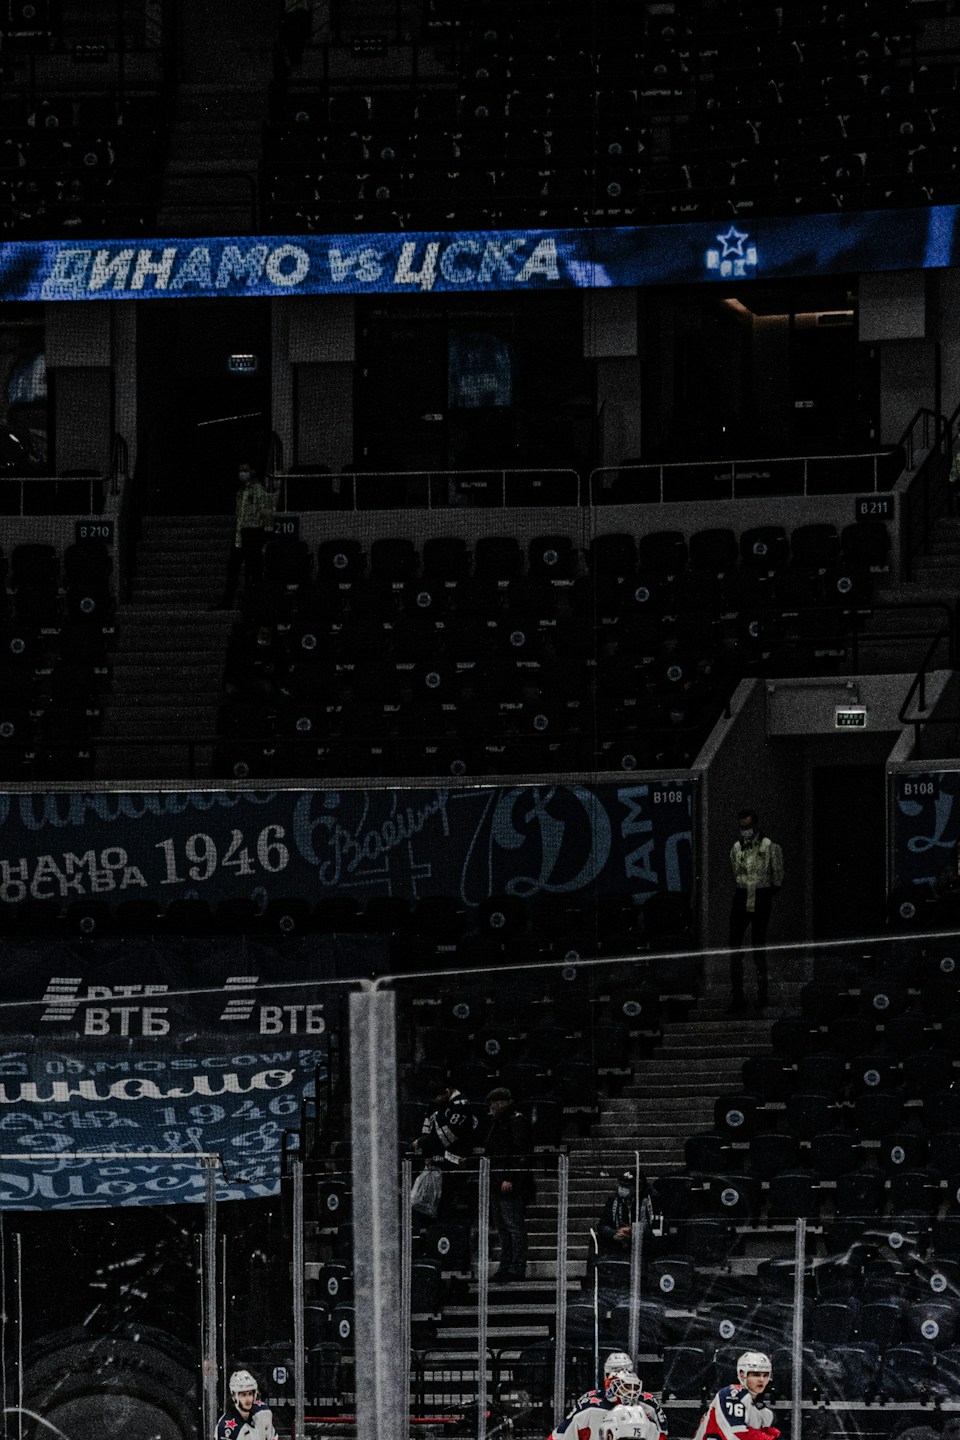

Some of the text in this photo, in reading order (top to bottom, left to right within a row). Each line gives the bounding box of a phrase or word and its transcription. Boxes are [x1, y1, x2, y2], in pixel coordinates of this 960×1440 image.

[43, 244, 310, 299] ДИНАМО
[394, 239, 559, 290] ЦСКА
[154, 824, 290, 885] 1946
[84, 1006, 171, 1036] ВТБ
[259, 1004, 326, 1035] ВТБ
[153, 1094, 300, 1127] 1946
[726, 1403, 744, 1417] 76
